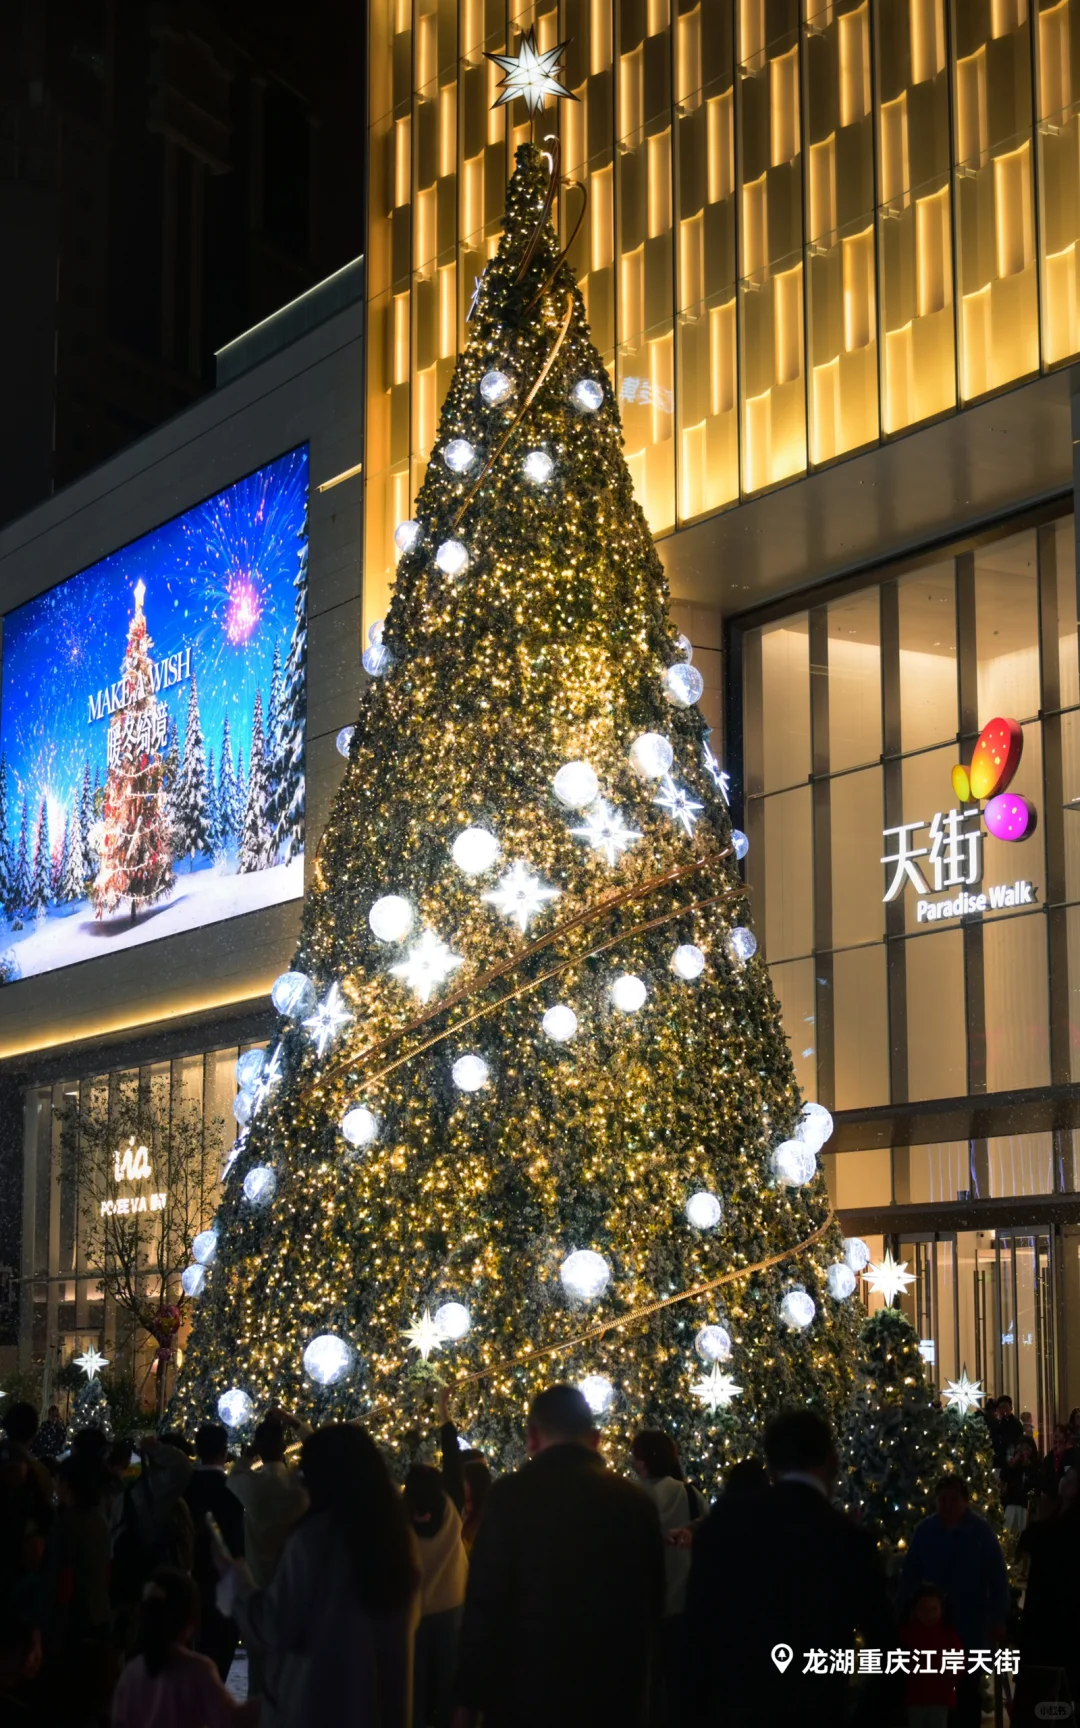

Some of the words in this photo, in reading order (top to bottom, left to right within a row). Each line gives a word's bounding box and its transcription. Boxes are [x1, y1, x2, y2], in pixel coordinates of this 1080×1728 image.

[88, 677, 132, 723] MAKE
[133, 671, 147, 701] A
[148, 648, 191, 692] WISH
[880, 808, 981, 902] 天街
[917, 892, 987, 922] Paradise
[989, 880, 1032, 909] Walk
